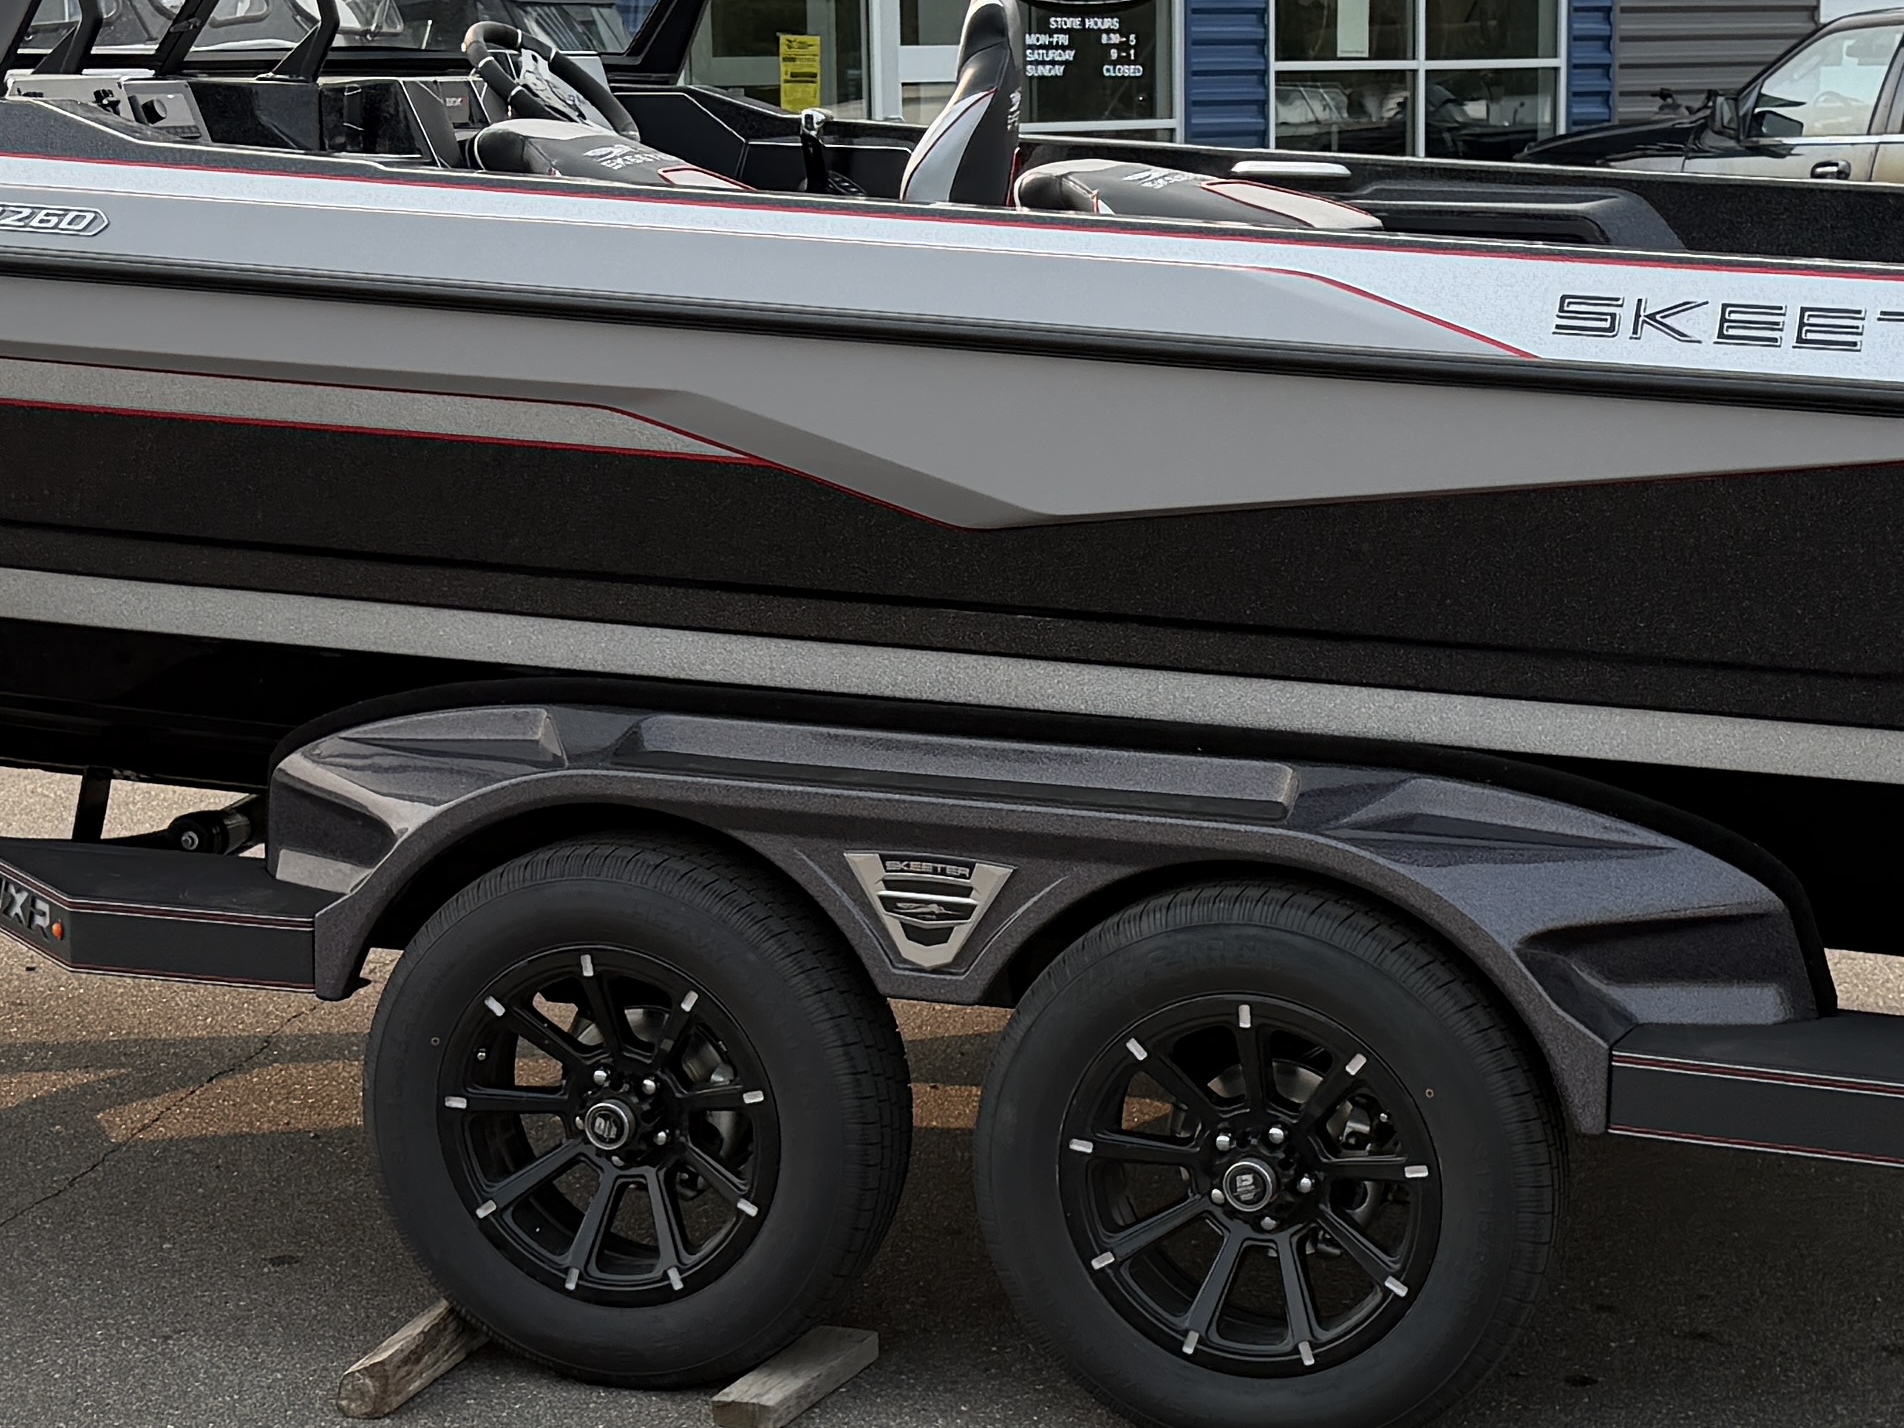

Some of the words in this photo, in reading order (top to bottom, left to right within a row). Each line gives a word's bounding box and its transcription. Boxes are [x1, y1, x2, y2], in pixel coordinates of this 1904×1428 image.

[1049, 17, 1081, 29] STORE
[1085, 18, 1120, 29] HOURS
[1025, 33, 1069, 46] MON-FRI
[1026, 49, 1075, 61] SATURDAY
[1025, 65, 1065, 77] SUNDAY
[1102, 65, 1143, 77] CLOSED
[884, 860, 970, 878] SKEETER
